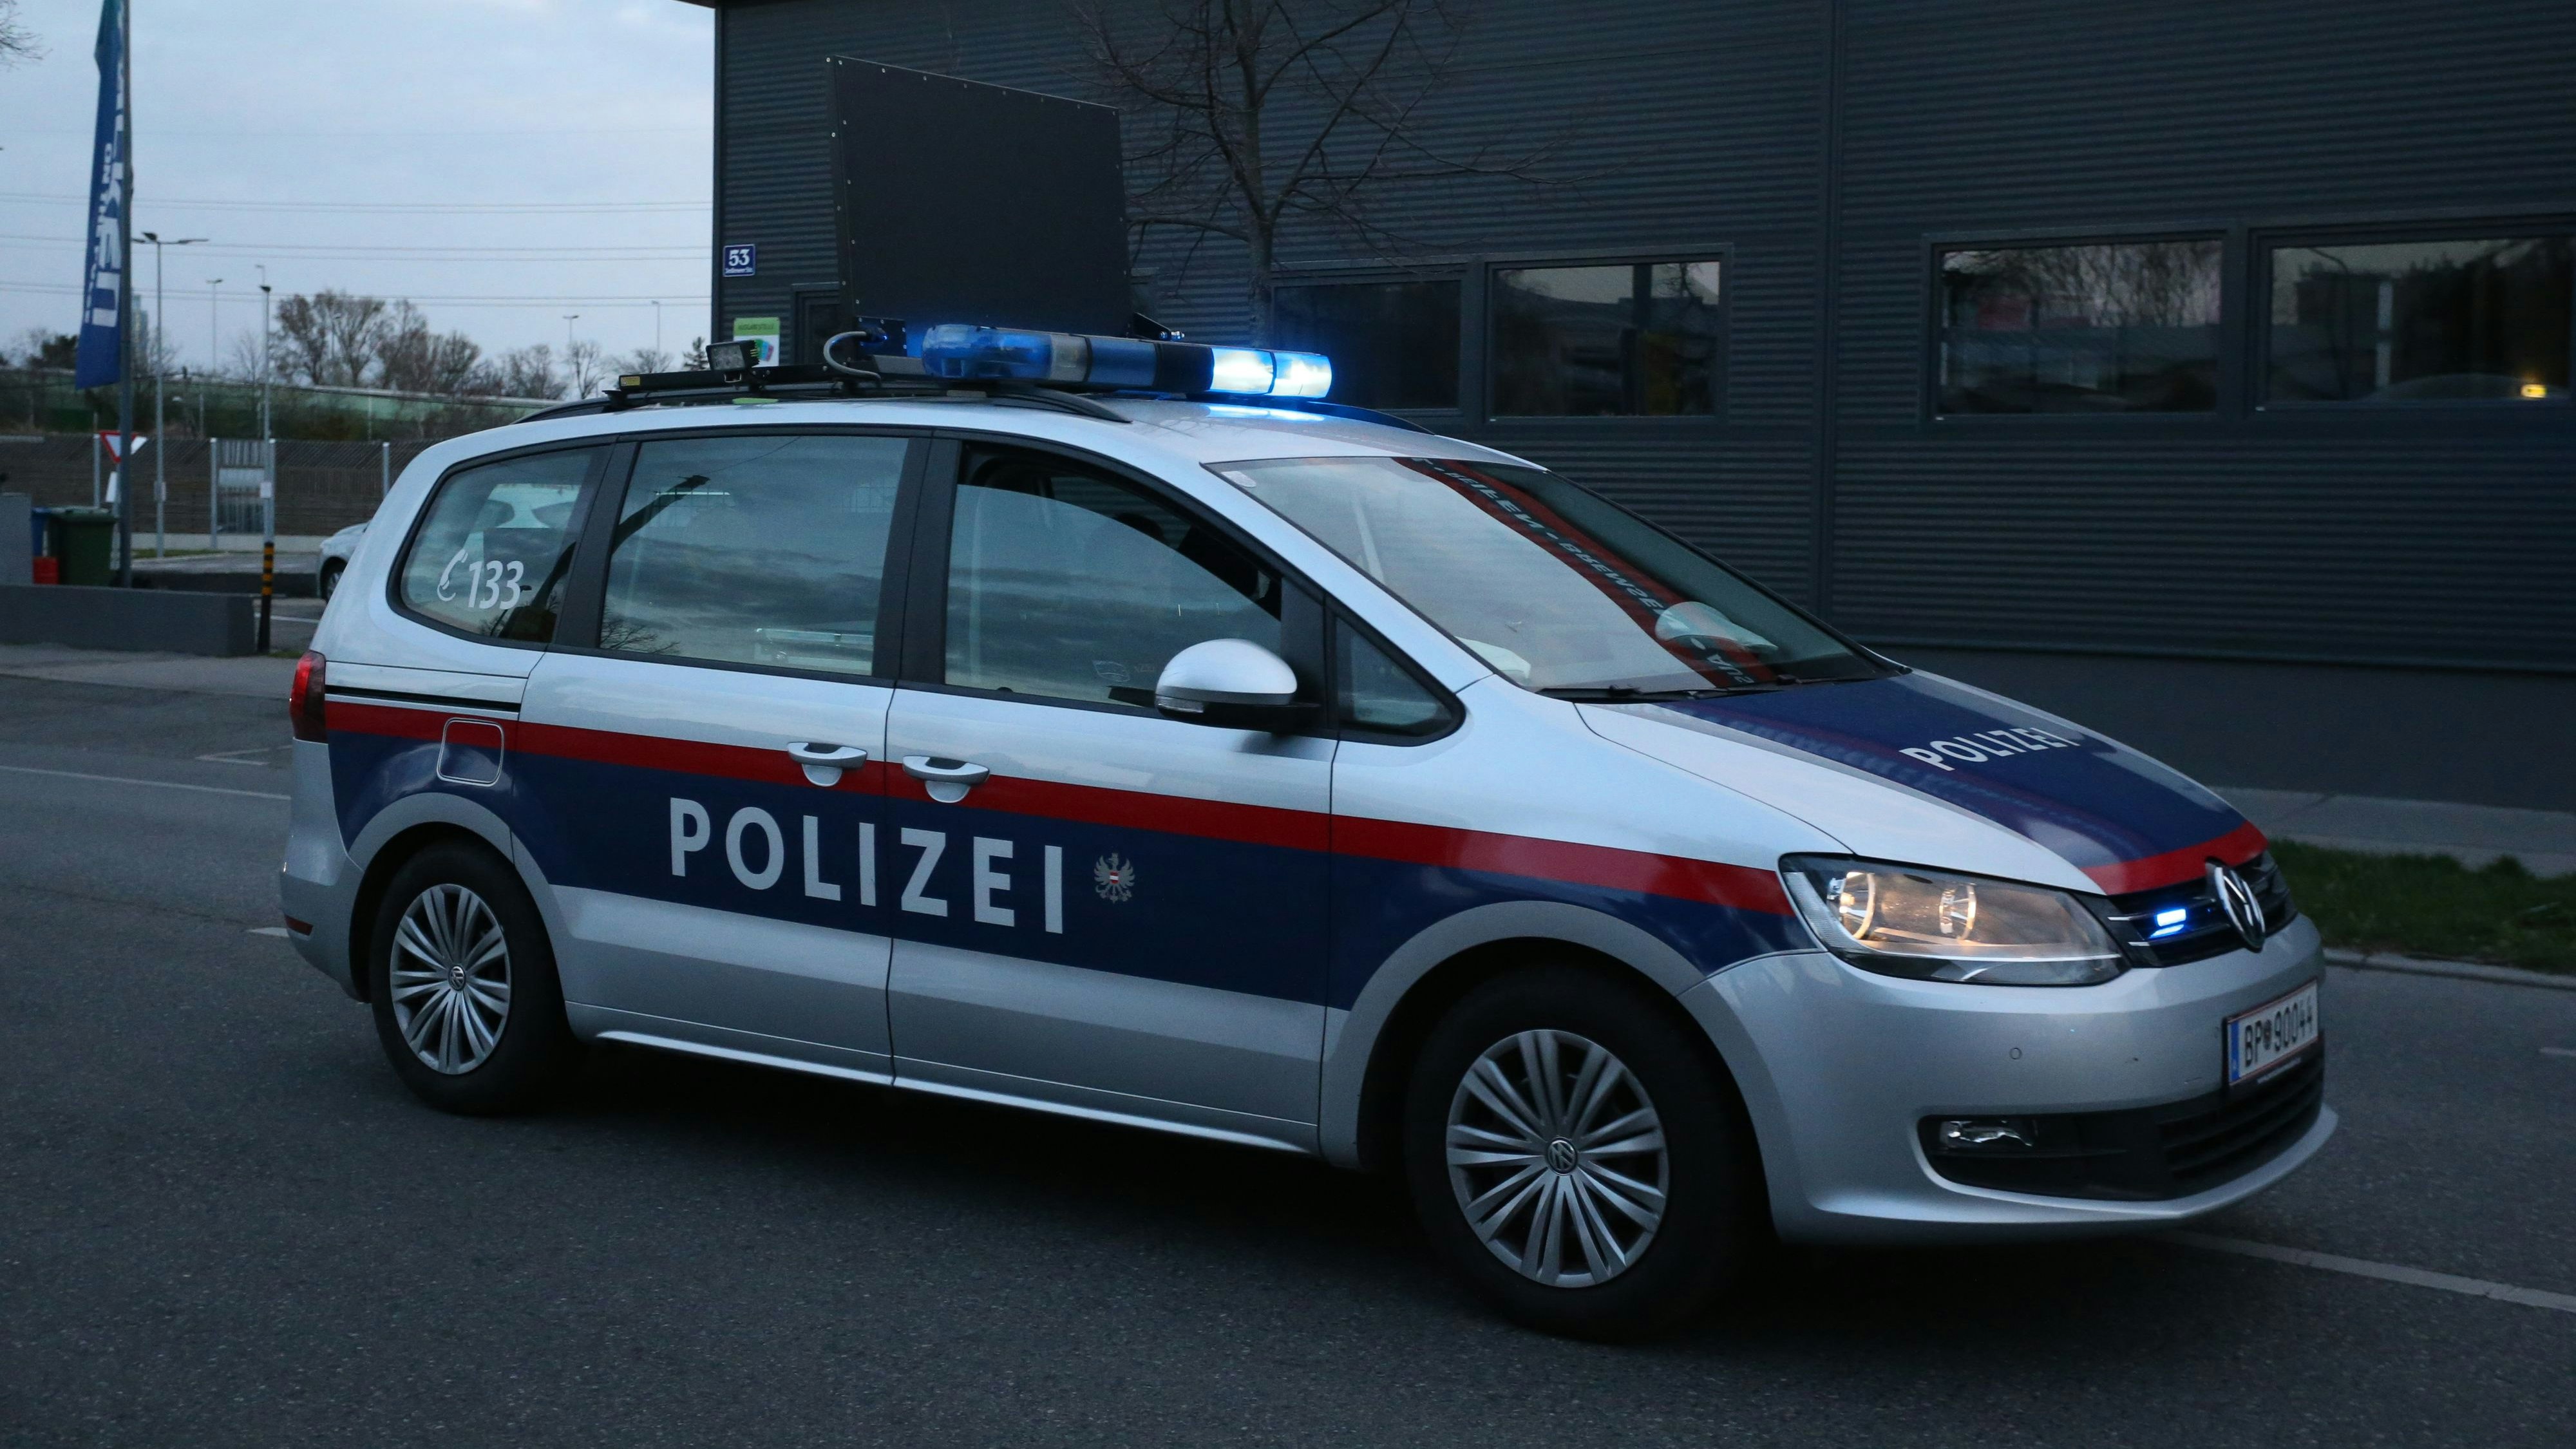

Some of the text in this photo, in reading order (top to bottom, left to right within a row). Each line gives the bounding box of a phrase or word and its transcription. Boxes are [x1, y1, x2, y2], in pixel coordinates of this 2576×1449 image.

[728, 249, 750, 266] 53
[468, 560, 524, 611] 133
[1899, 727, 2081, 772] POLIZEI
[670, 797, 1063, 934] POLIZEI
[2244, 1019, 2263, 1067] BP
